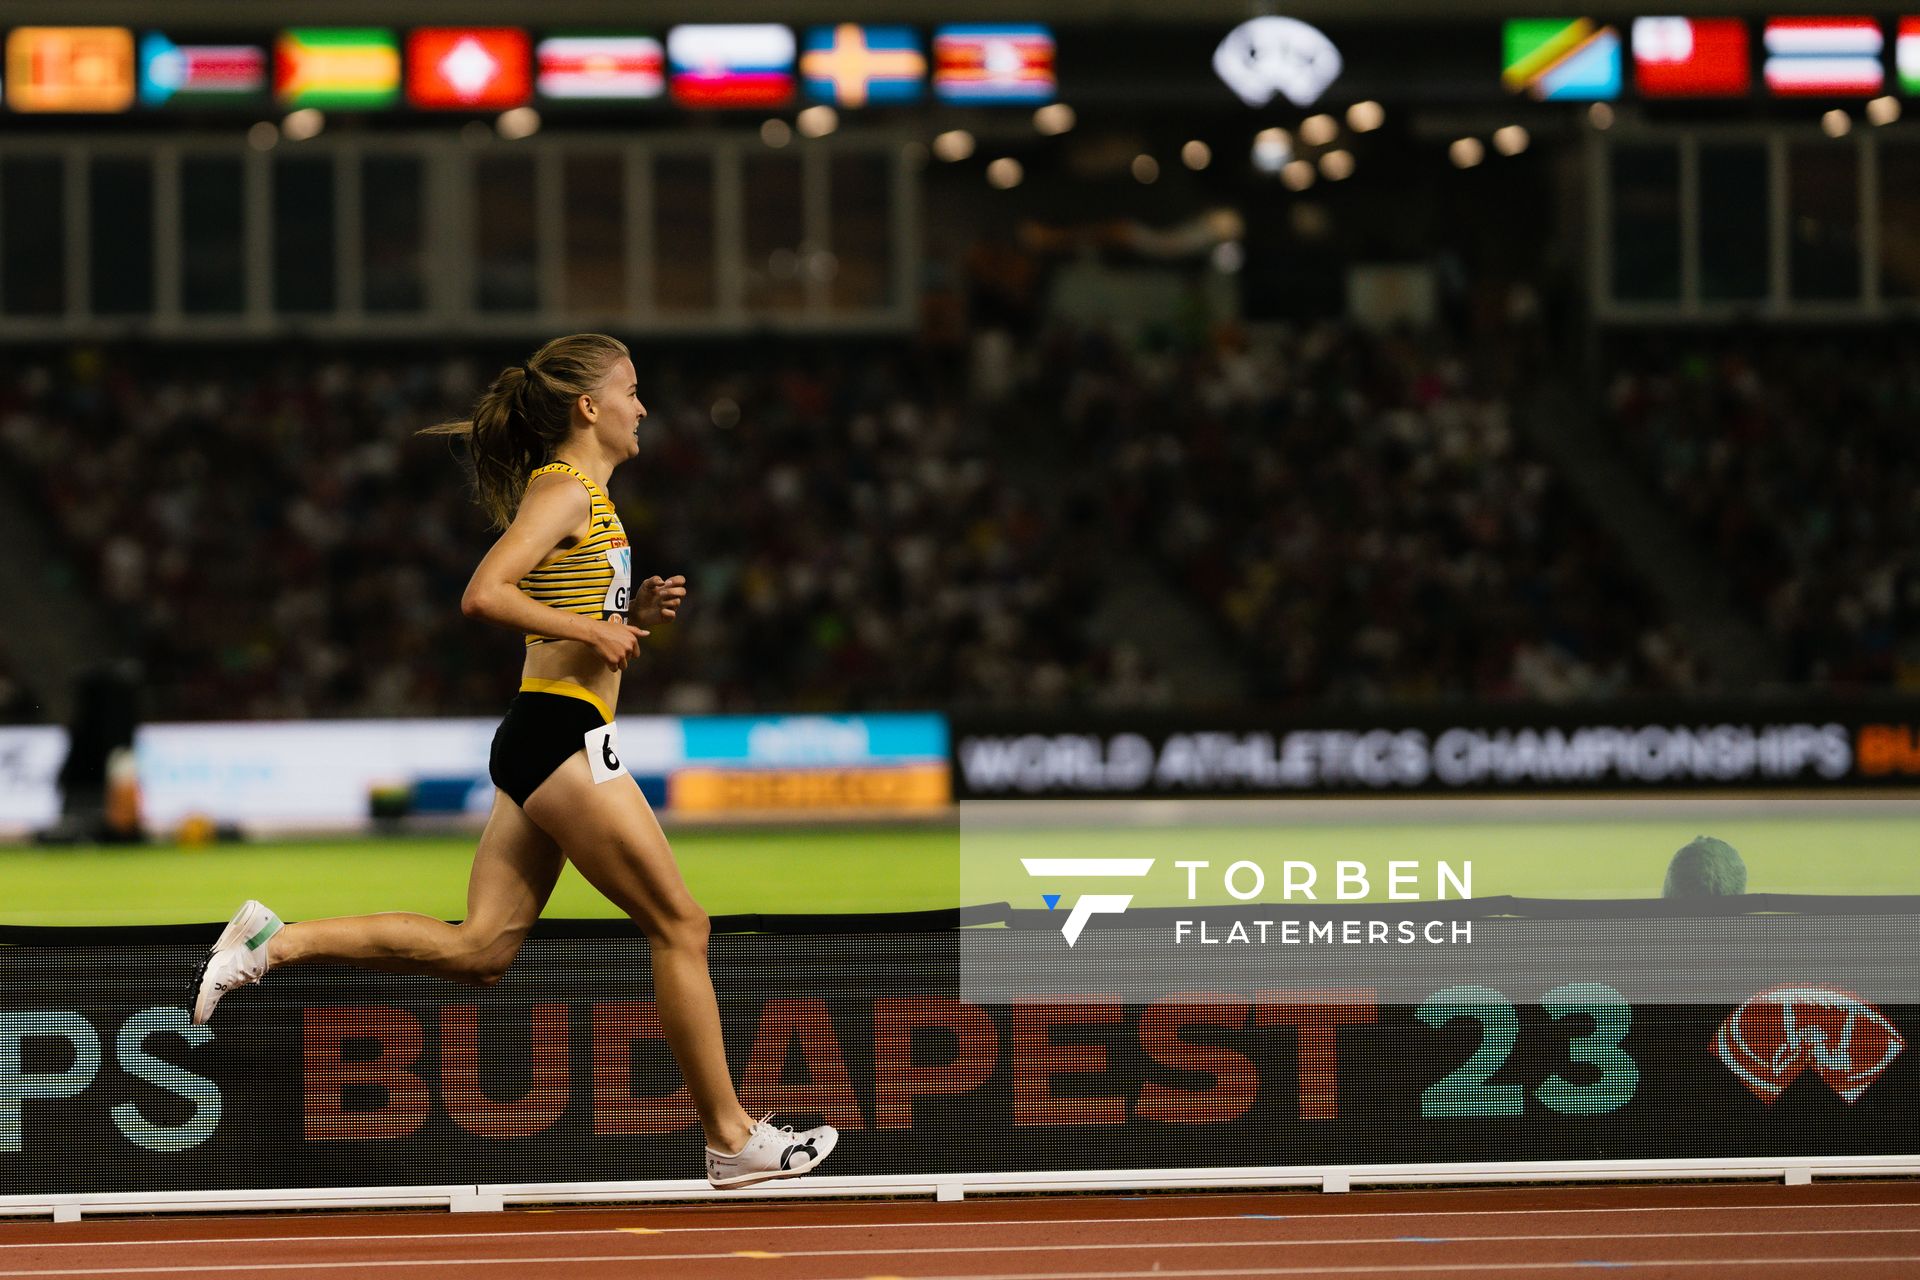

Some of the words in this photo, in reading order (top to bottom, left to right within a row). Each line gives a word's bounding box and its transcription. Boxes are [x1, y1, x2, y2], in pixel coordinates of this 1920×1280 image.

[602, 733, 620, 771] 6
[303, 988, 1378, 1140] BUDAPEST
[1414, 983, 1640, 1118] 23
